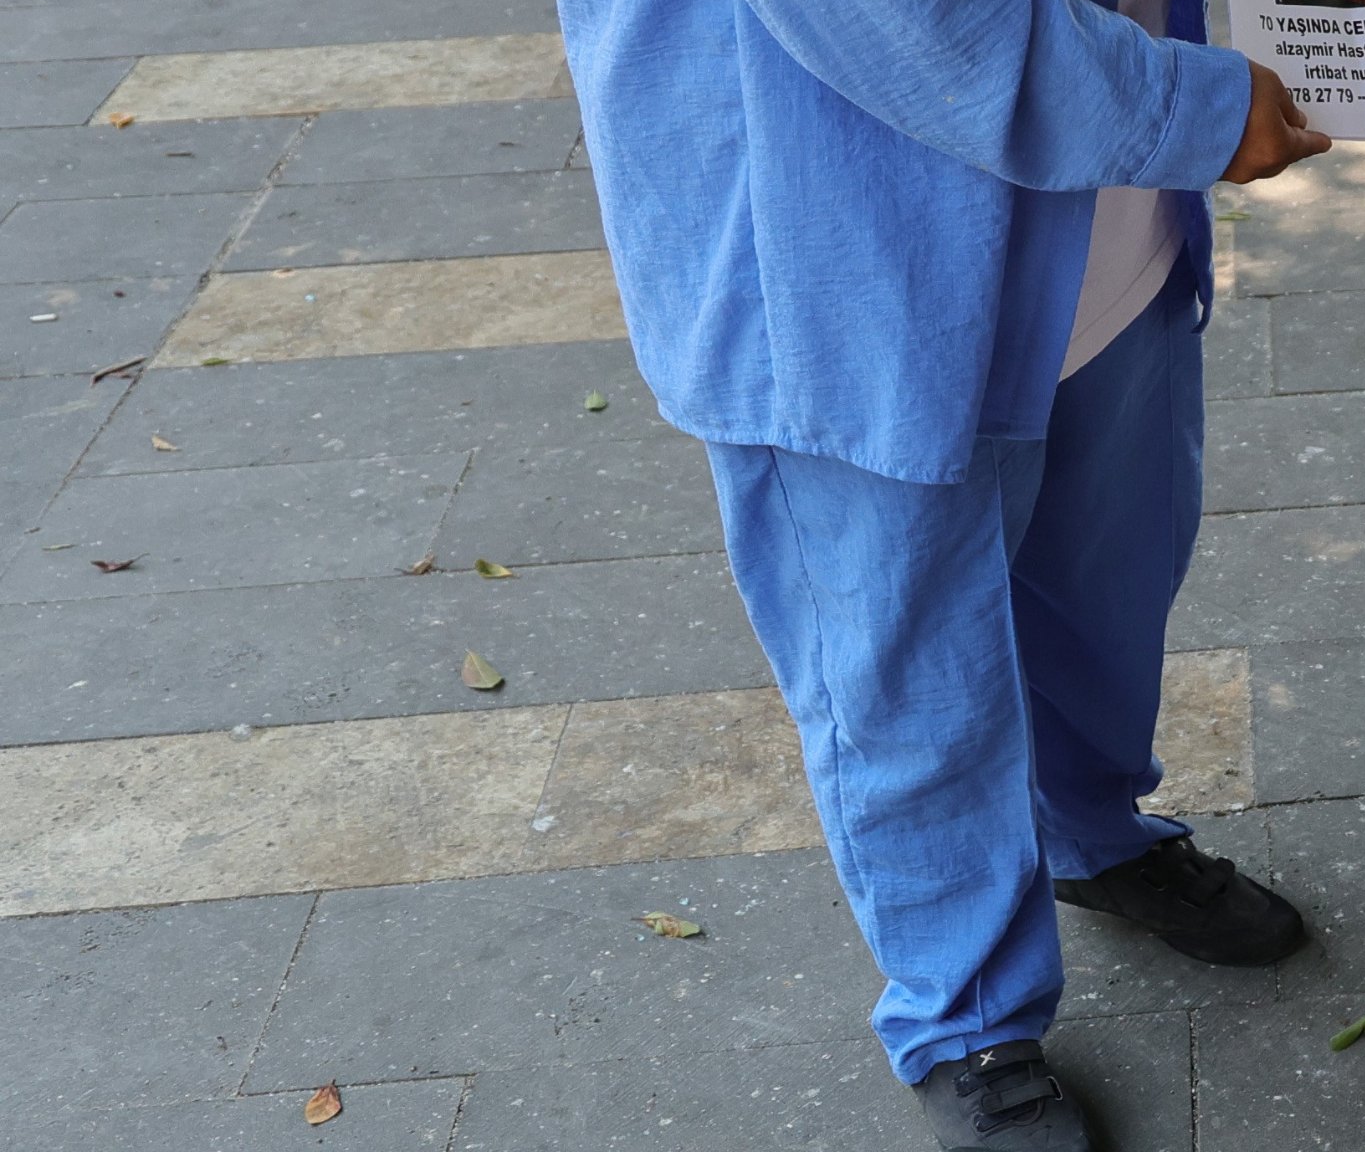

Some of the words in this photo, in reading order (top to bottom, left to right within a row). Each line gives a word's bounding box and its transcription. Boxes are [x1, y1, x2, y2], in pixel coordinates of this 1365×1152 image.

[1260, 15, 1273, 31] 70
[1276, 16, 1340, 36] YAŞINDA
[1275, 41, 1334, 60] alzaymir
[1305, 64, 1348, 80] irtibat
[1315, 88, 1332, 103] 27
[1338, 88, 1354, 103] 79
